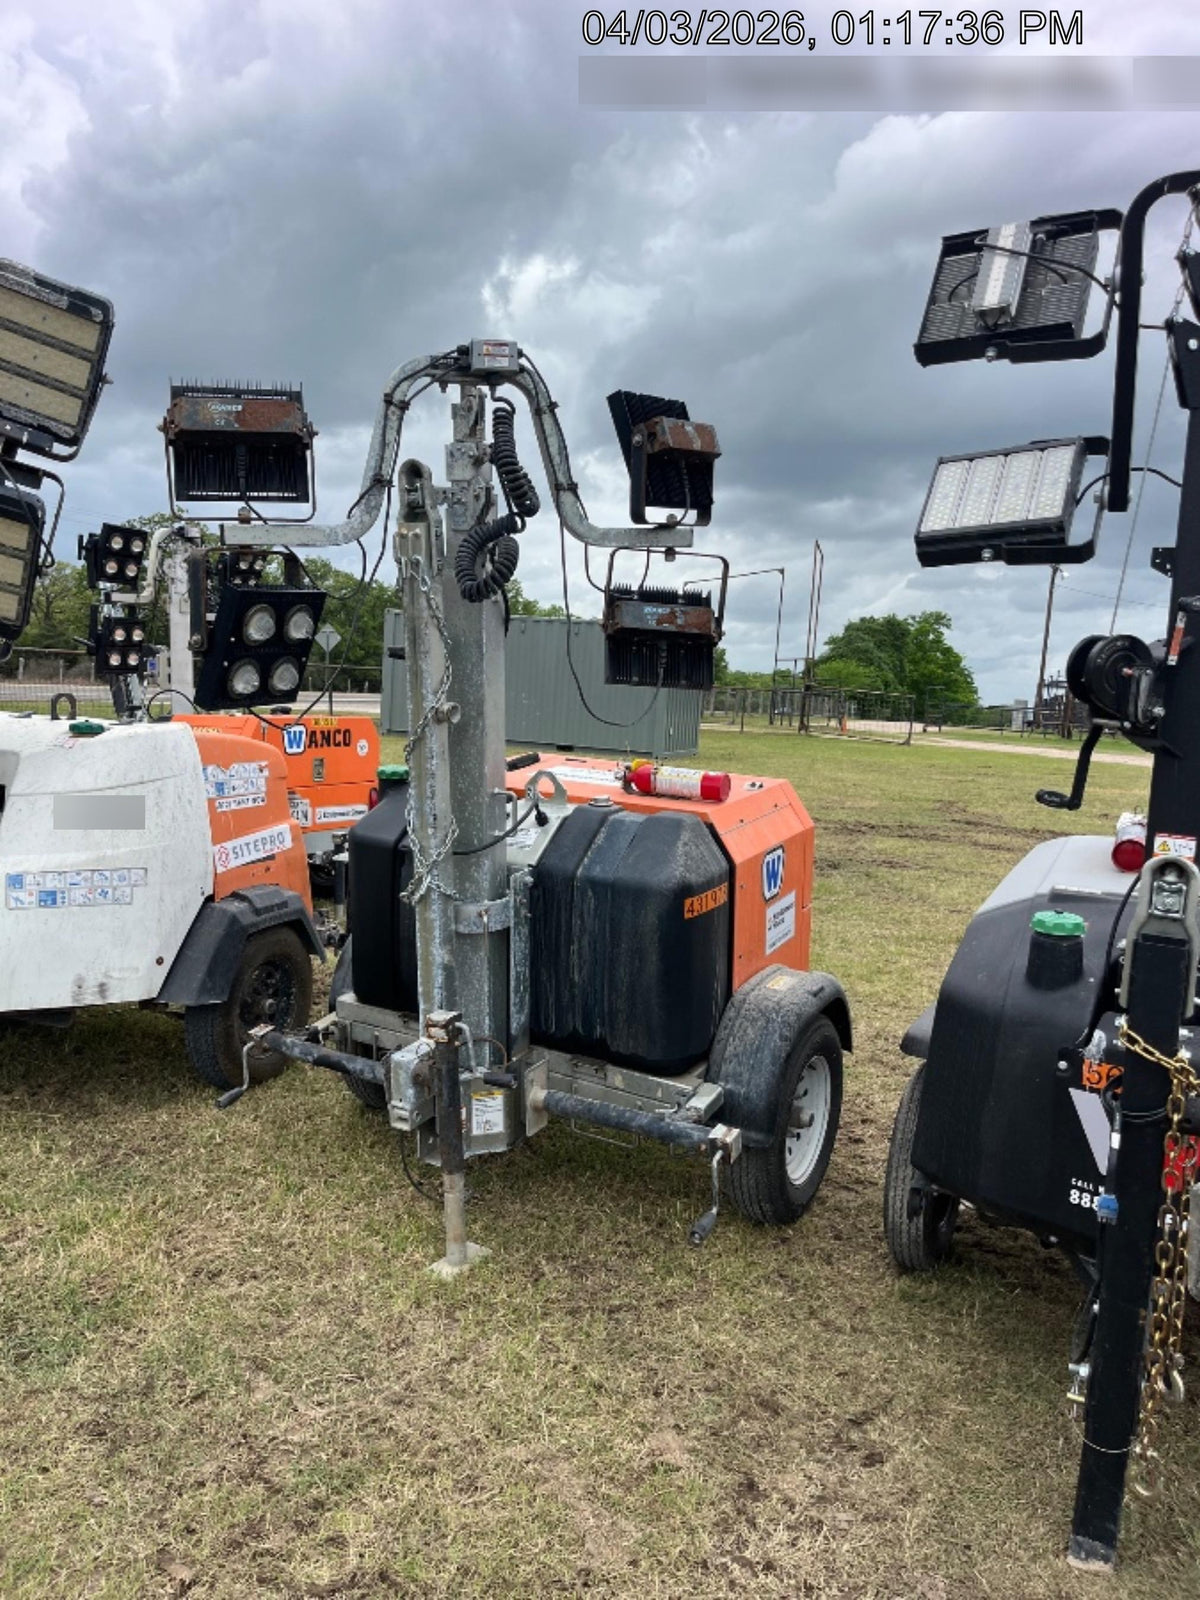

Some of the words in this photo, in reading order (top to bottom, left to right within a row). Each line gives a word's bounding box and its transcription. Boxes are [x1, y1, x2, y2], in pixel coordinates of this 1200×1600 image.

[285, 728, 351, 750] WANCO
[231, 831, 286, 860] SITEPRO
[1071, 1177, 1095, 1192] CALL
